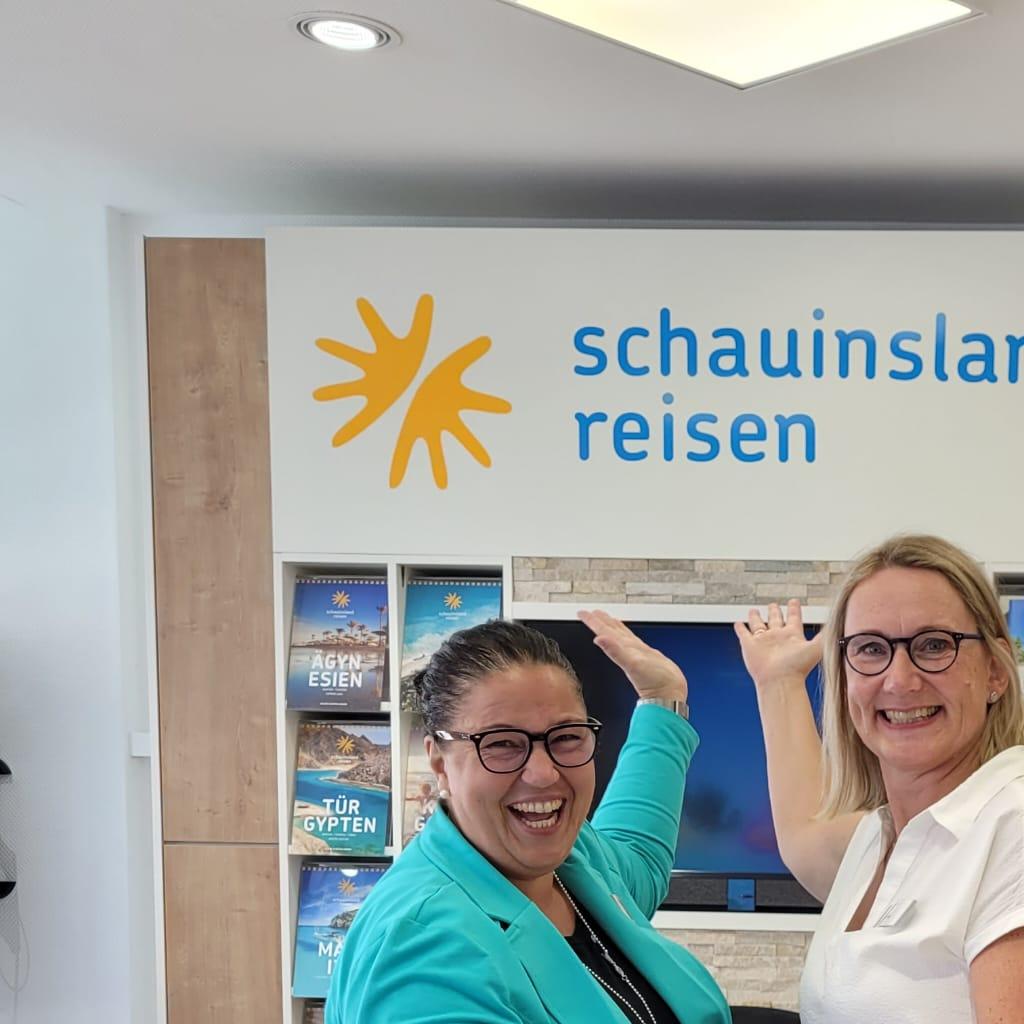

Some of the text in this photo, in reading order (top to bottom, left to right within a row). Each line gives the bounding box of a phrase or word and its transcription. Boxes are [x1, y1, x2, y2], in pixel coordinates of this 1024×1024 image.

[574, 392, 816, 463] reisen
[311, 649, 361, 670] ÄGYN
[308, 671, 363, 688] ESIEN
[322, 794, 361, 815] TÜR
[303, 816, 377, 833] GYPTEN
